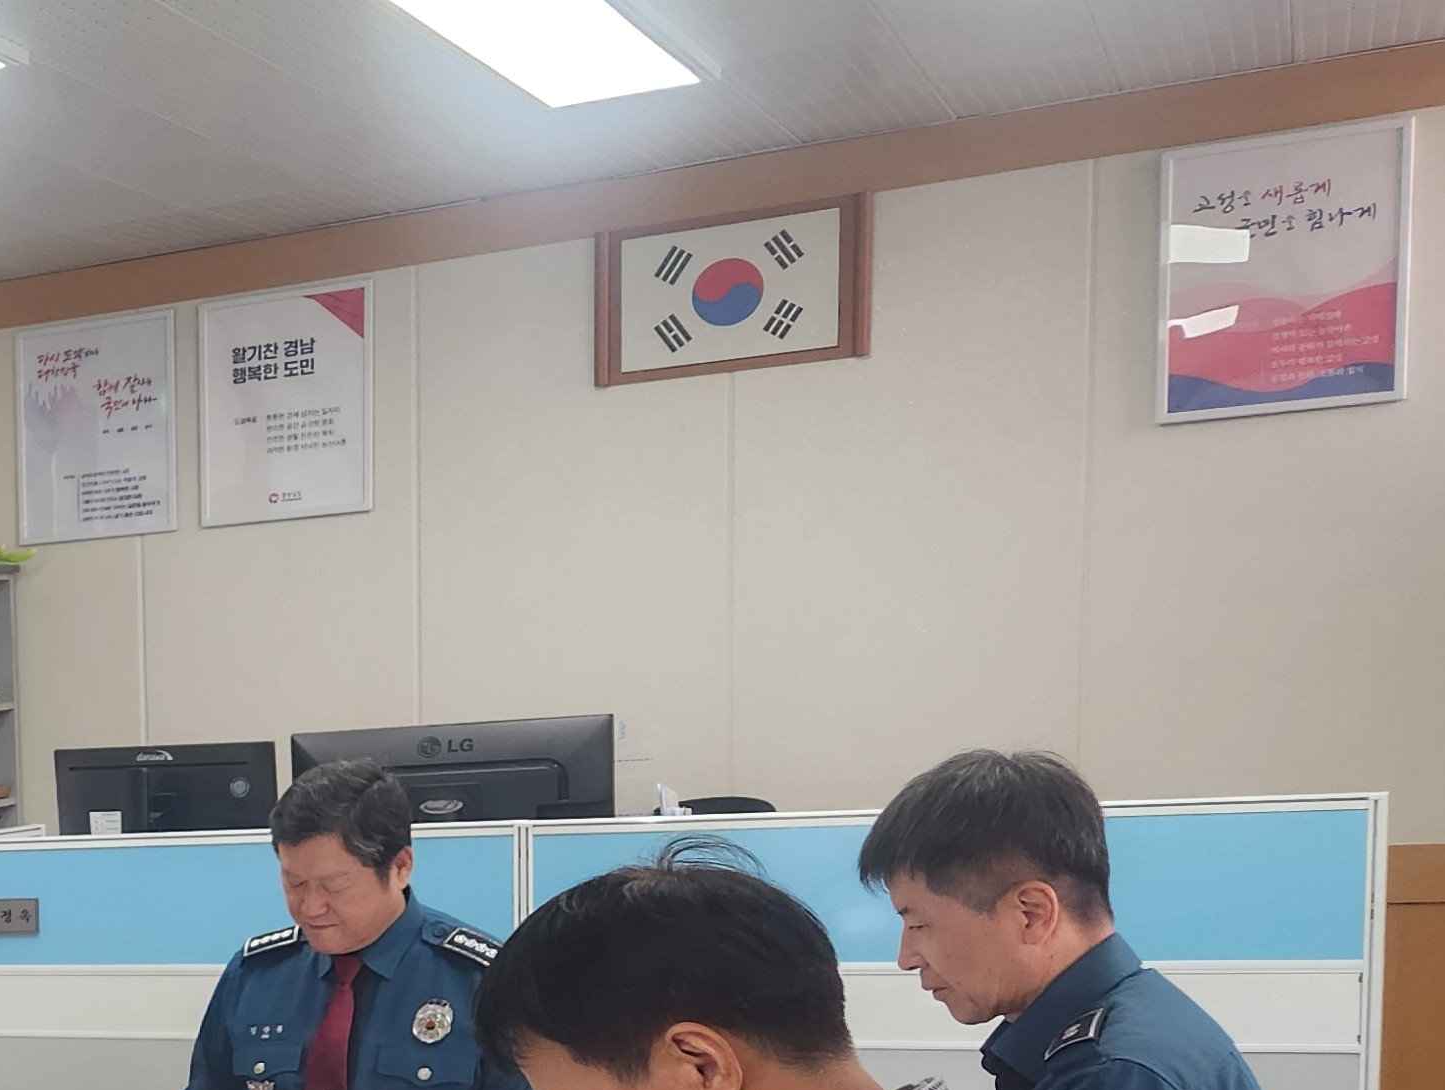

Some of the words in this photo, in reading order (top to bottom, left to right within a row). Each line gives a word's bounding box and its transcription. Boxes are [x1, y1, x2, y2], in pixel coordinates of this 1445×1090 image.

[1261, 179, 1331, 205] 새롭게
[1306, 203, 1377, 231] 힘나게
[231, 342, 279, 364] 활기찬
[283, 337, 316, 357] 경남
[232, 362, 279, 384] 행복한
[283, 357, 315, 378] 도민
[447, 738, 475, 753] LG
[0, 909, 13, 923] 정
